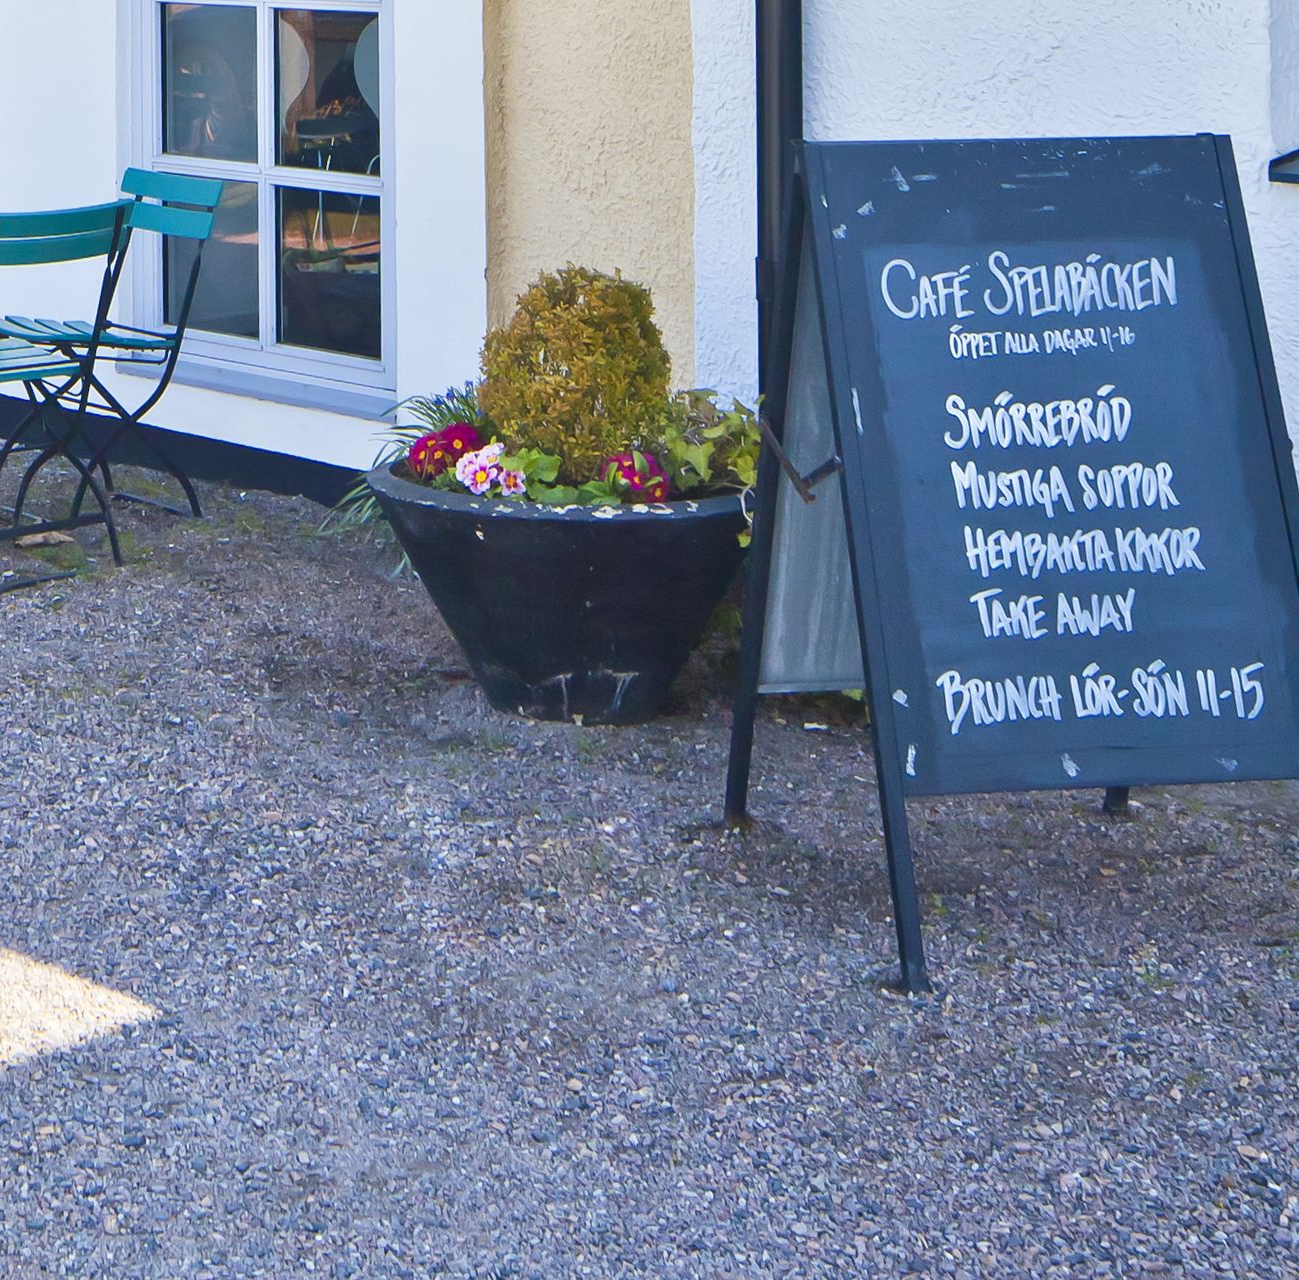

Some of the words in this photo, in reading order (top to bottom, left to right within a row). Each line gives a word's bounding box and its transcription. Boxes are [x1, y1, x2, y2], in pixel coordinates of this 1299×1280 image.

[881, 258, 975, 320] CAFÉ
[1043, 327, 1097, 356] DAGAR
[950, 460, 1076, 519] MUSTIGA
[1077, 461, 1181, 511] SOPPOR
[963, 524, 1115, 580] HEMBAKTA
[1114, 525, 1206, 576] KAKOR
[968, 587, 1050, 640] TAKE
[1056, 587, 1136, 637] AWAY
[935, 669, 1063, 736] BRUNCH
[1196, 661, 1265, 720] 11-15
